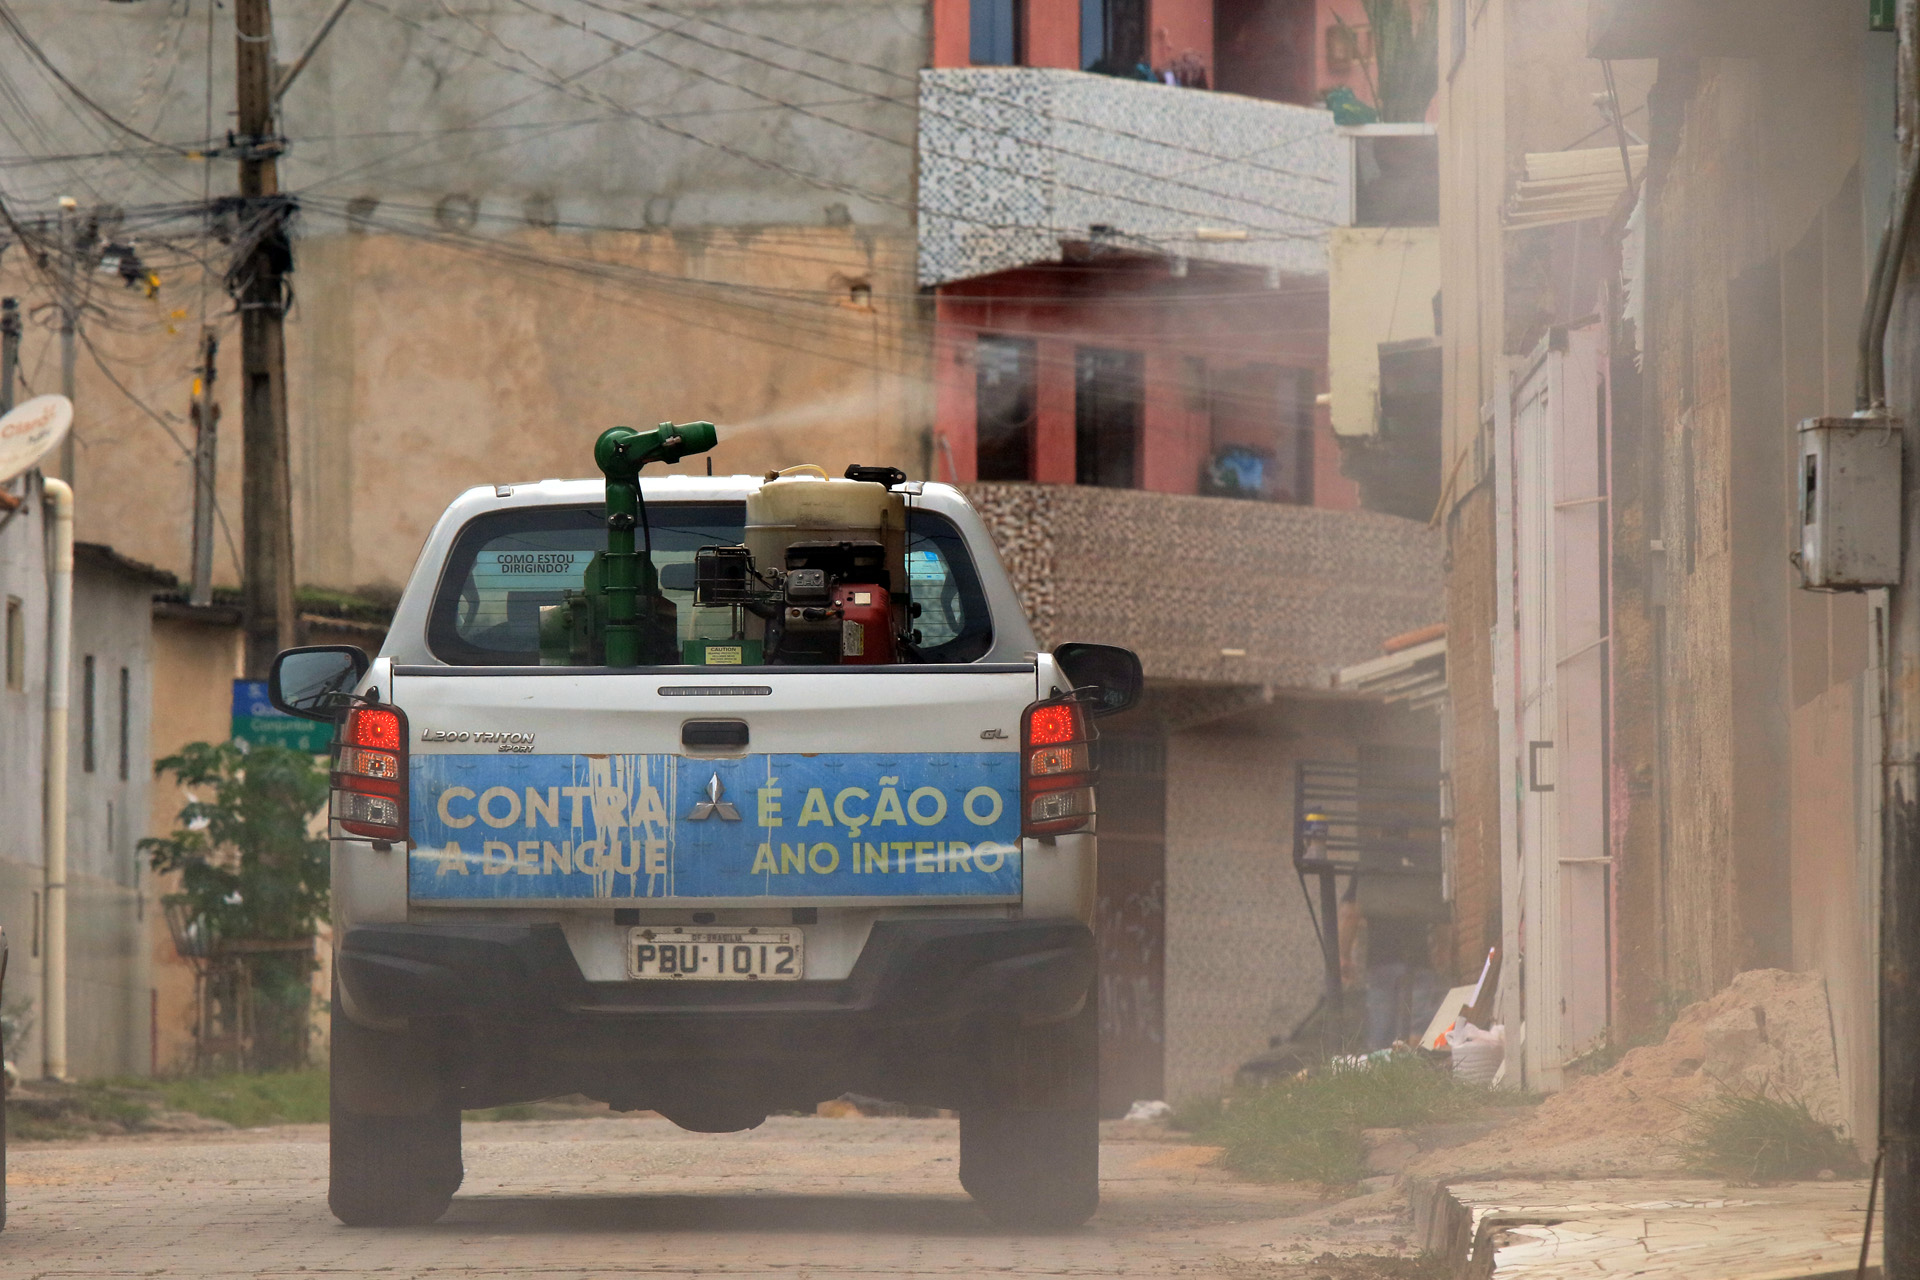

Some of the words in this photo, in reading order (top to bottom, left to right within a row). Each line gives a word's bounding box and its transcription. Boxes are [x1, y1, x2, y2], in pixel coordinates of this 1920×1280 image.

[497, 554, 534, 564] COMO
[537, 554, 574, 564] ESTOU
[501, 563, 570, 573] DIRIGINDO?
[421, 728, 470, 742] L200
[473, 732, 535, 743] TRITON
[980, 728, 1008, 740] GL
[498, 744, 535, 753] SPORT
[437, 786, 668, 828] CONTRA
[757, 777, 783, 827] É
[797, 776, 948, 838] AÇÃO
[963, 786, 1003, 826] O
[436, 841, 469, 875] A
[483, 840, 667, 875] DENGUE
[751, 842, 840, 874] ANO
[853, 841, 1005, 873] INTEIRO
